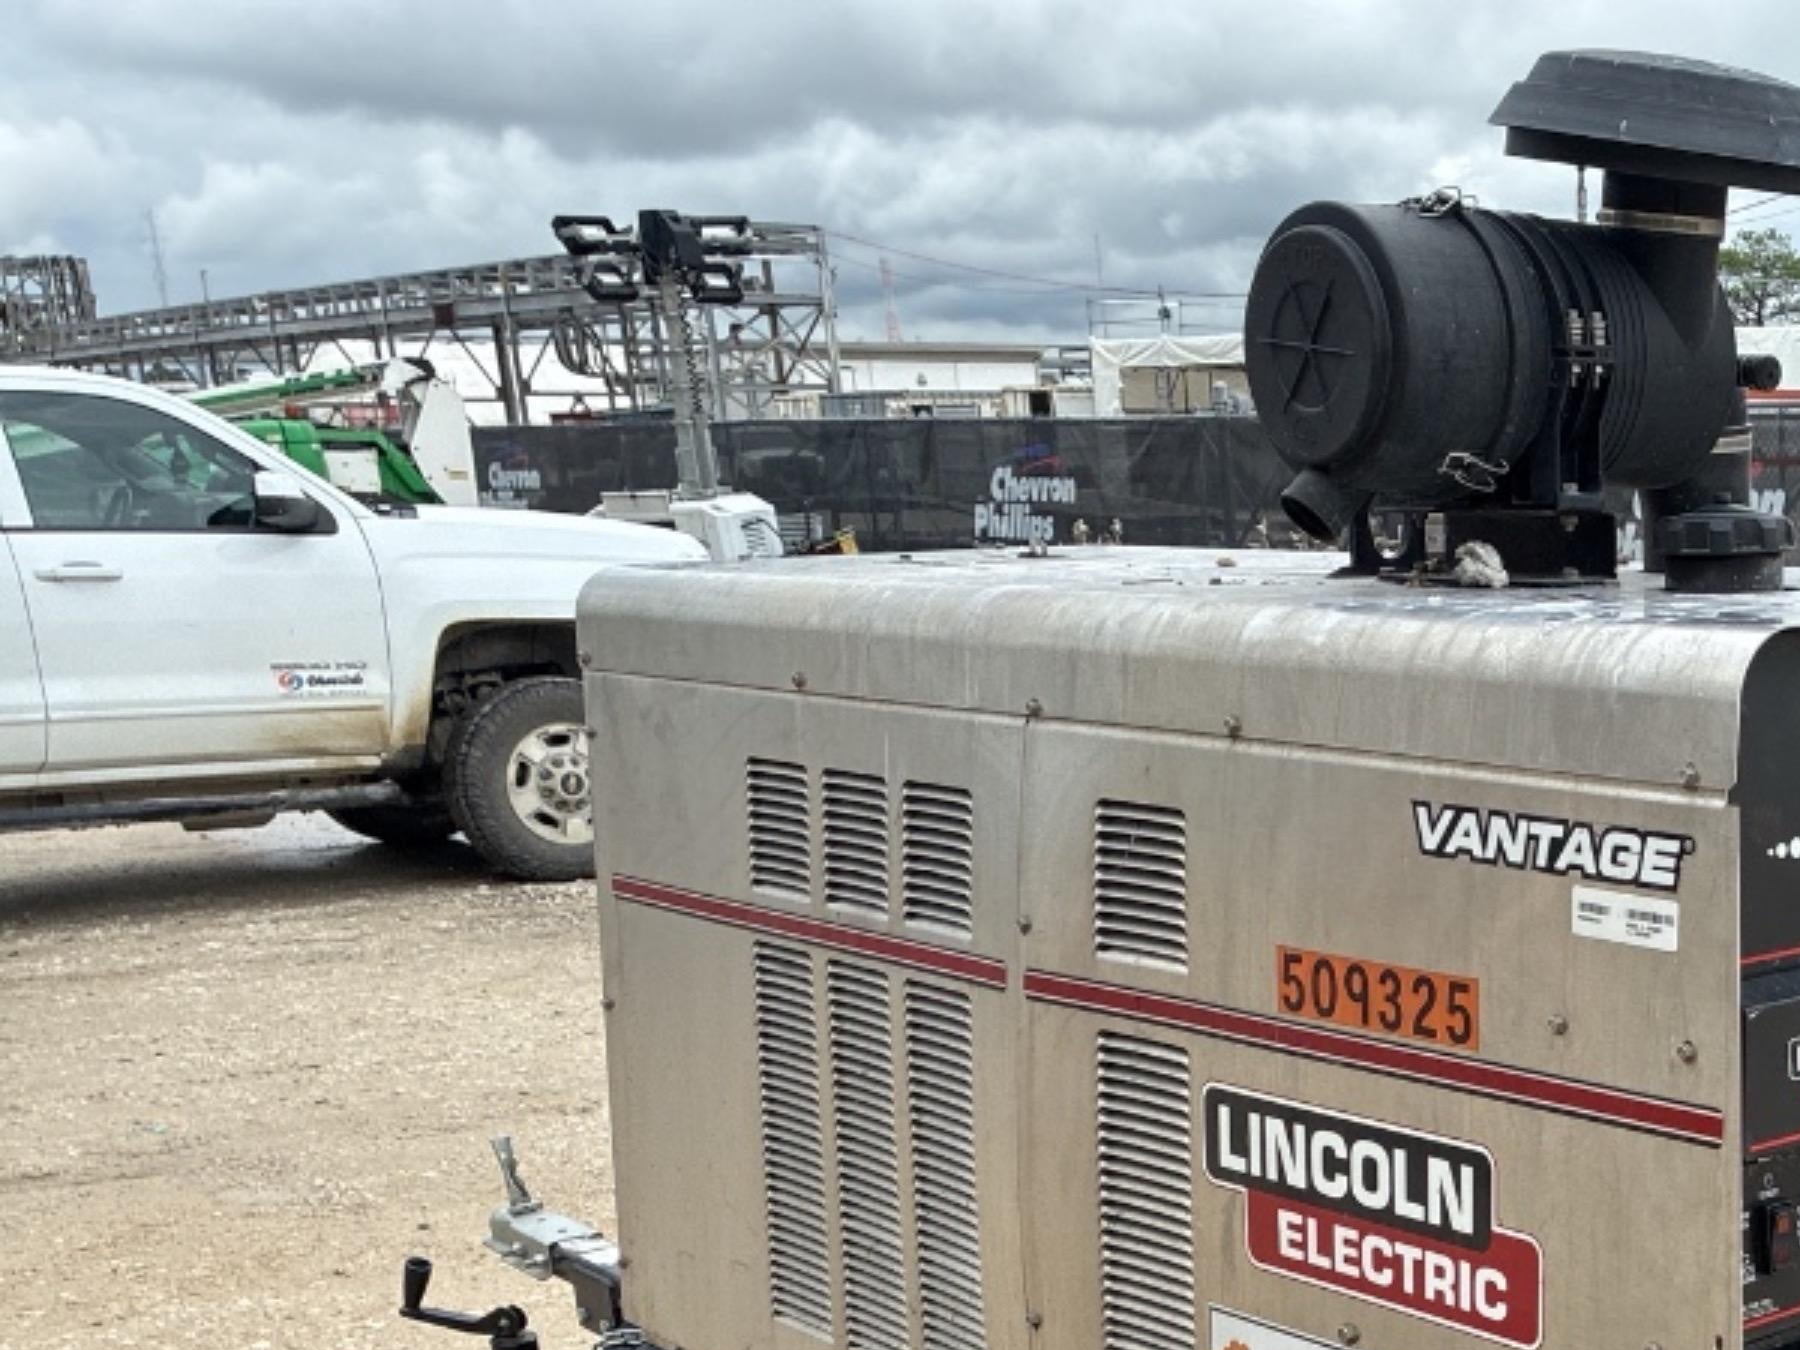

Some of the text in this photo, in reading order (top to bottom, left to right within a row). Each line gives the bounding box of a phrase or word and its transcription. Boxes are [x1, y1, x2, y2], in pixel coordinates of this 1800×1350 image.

[990, 465, 1076, 504] Chevron
[1412, 801, 1684, 892] VANTAGE
[1281, 952, 1472, 1045] 509325
[1215, 1103, 1475, 1236] LINCOLN
[1276, 1207, 1509, 1322] ELECTRIC
